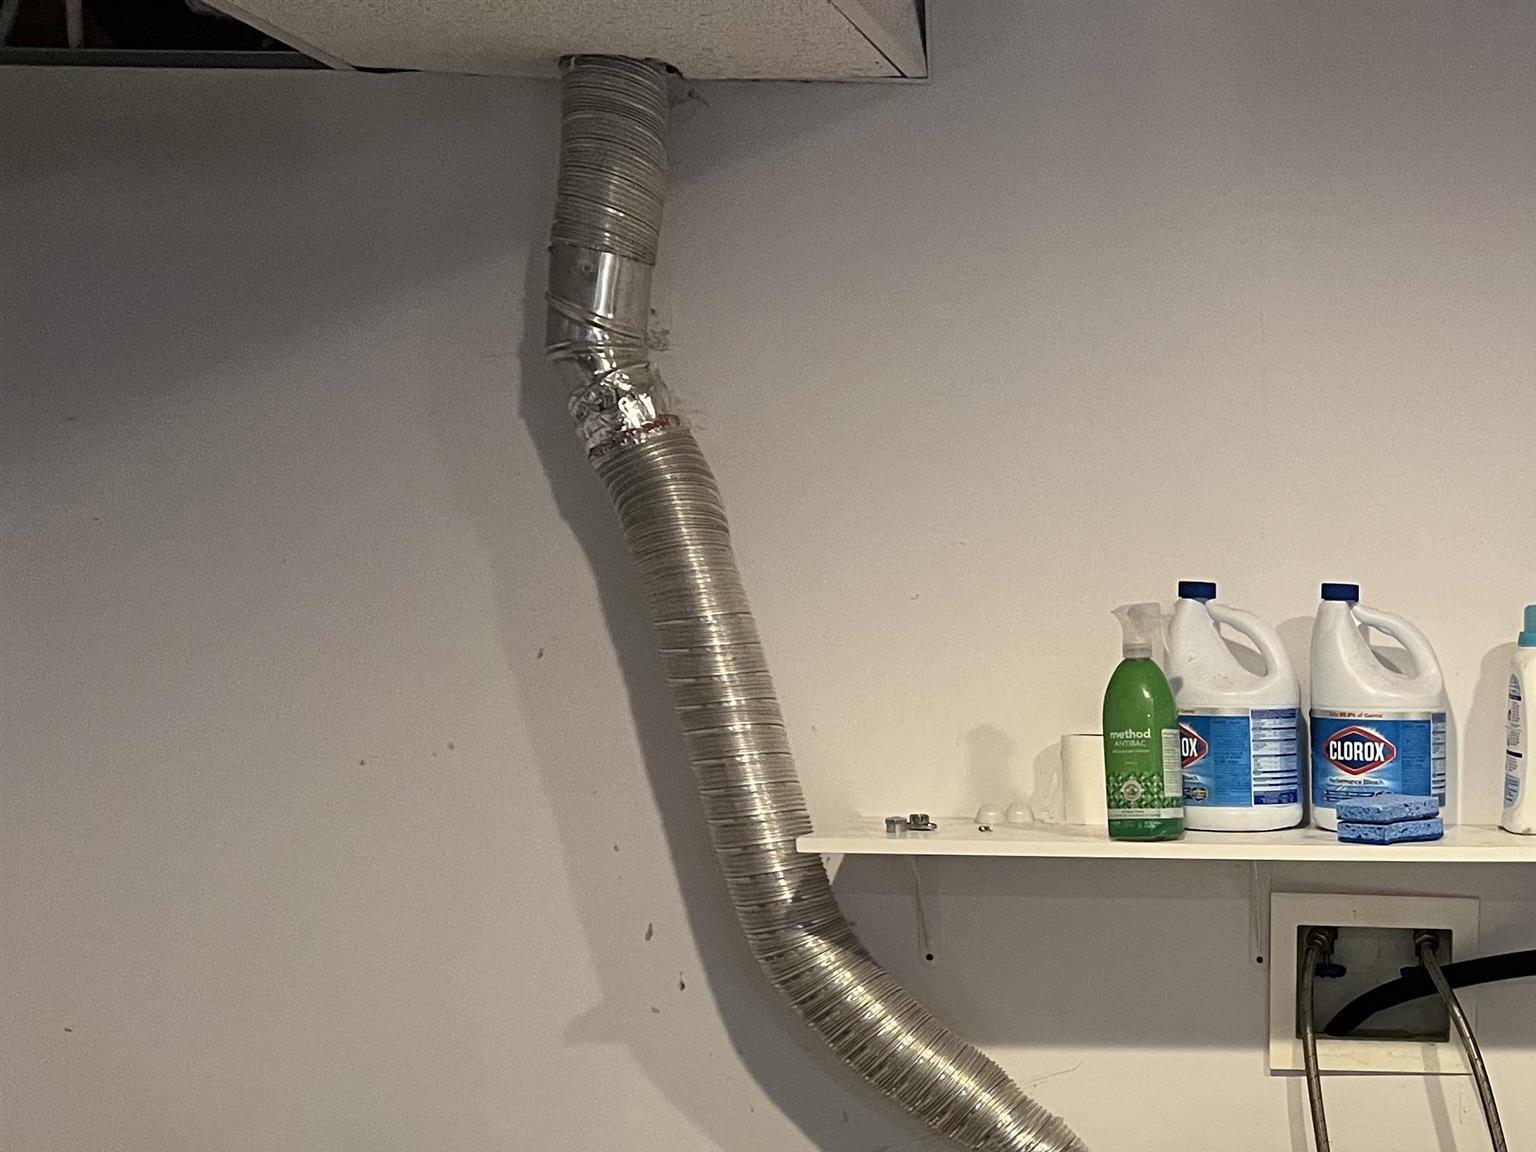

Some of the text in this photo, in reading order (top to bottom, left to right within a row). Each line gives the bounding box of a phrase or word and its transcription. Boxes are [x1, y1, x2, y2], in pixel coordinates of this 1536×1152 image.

[1110, 728, 1151, 739] method
[1115, 740, 1146, 748] ANTIBAC
[1329, 740, 1385, 761] CLOROX
